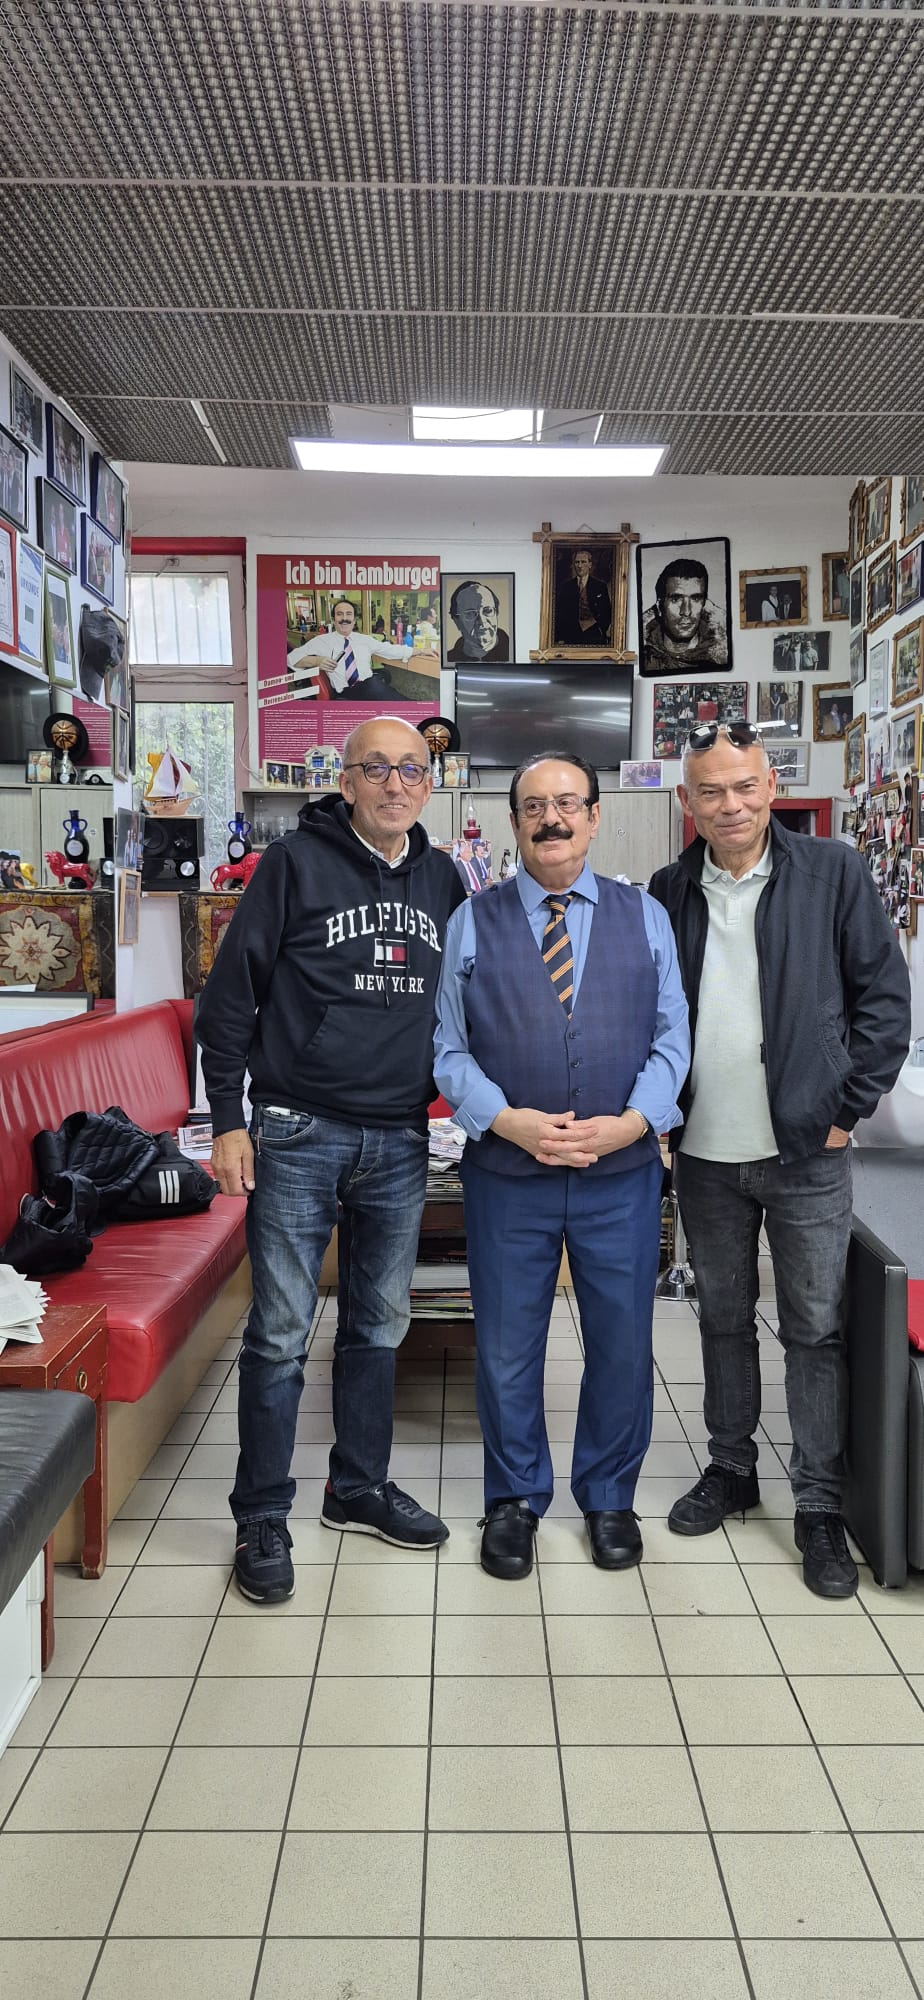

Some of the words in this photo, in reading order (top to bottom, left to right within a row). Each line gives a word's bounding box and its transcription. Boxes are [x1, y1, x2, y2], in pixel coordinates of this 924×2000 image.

[285, 560, 311, 585] Ich
[314, 560, 342, 585] bin
[345, 561, 439, 590] Hamburger
[326, 902, 442, 953] HILFIGER
[354, 974, 390, 992] NEW
[391, 975, 425, 994] YORK
